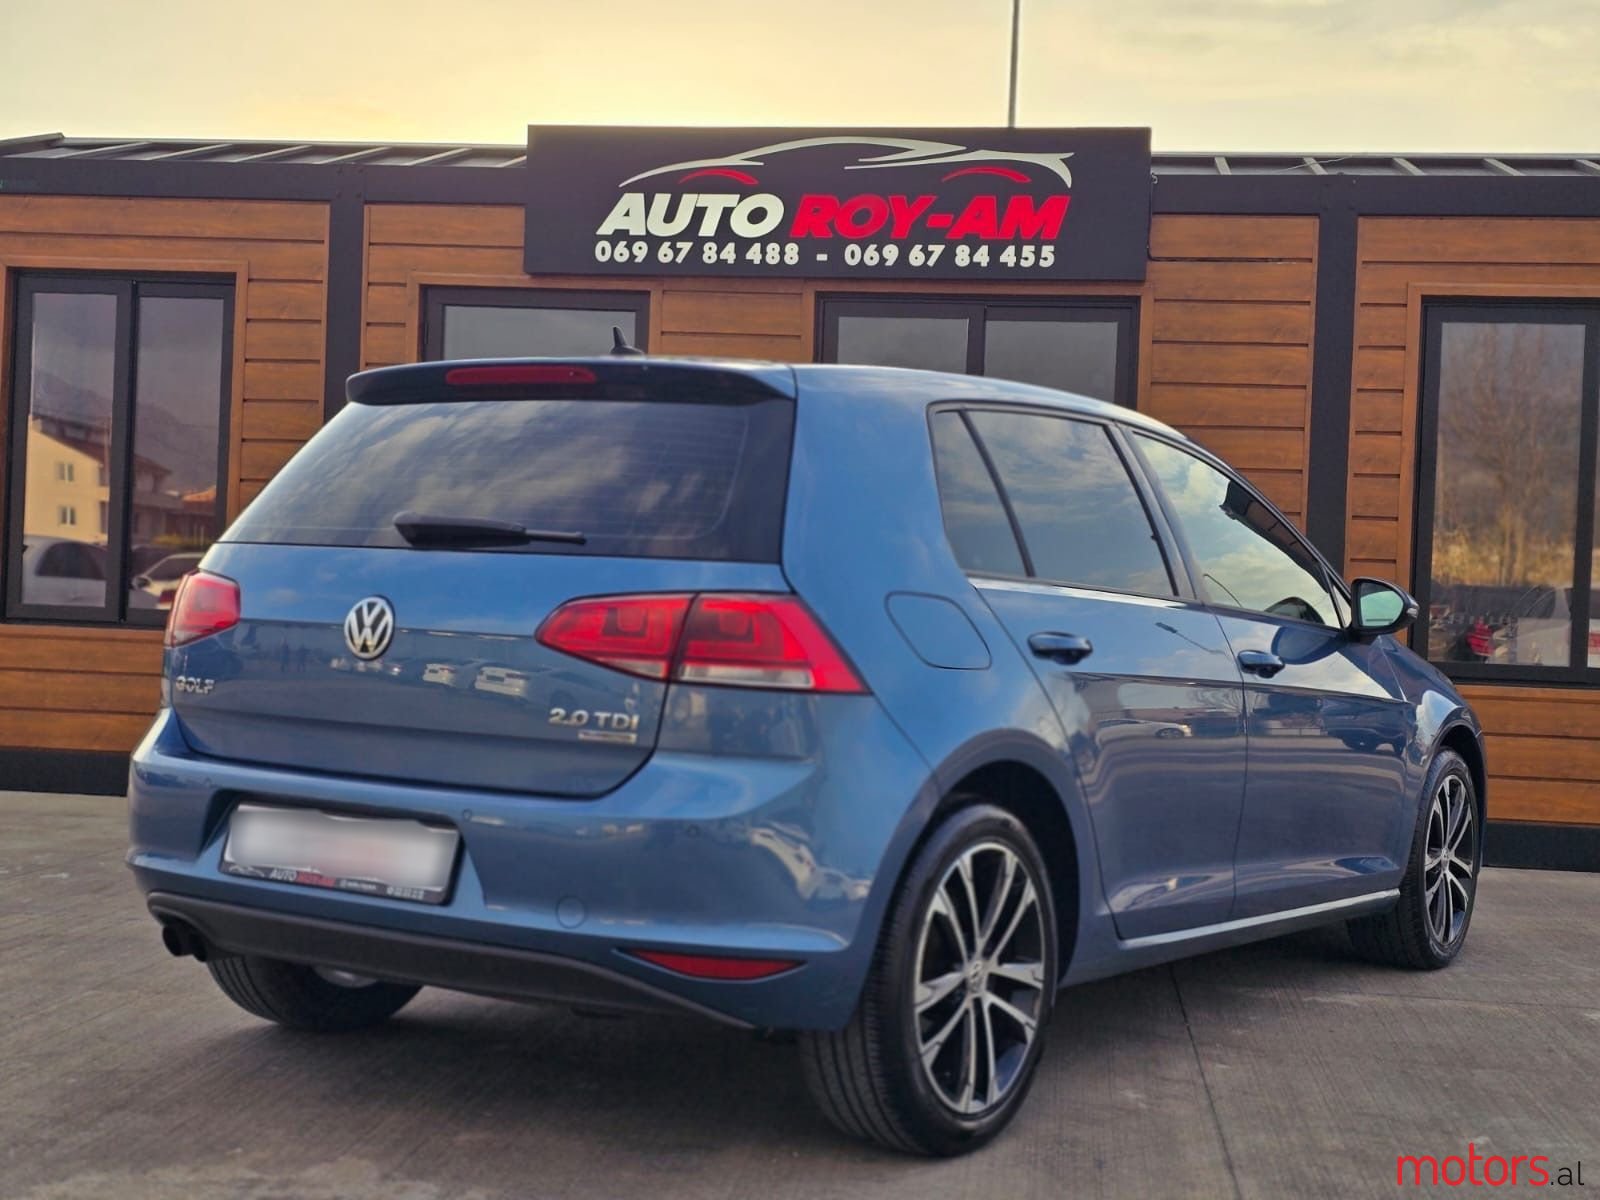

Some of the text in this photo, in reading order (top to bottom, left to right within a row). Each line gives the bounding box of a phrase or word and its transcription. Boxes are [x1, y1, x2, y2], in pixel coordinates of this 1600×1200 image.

[595, 192, 1071, 240] AUTO ROY-AM
[595, 240, 649, 263] 069
[657, 241, 694, 263] 67
[702, 241, 737, 264] 84
[745, 242, 799, 265] 488
[844, 243, 900, 266] 069
[908, 244, 946, 267] 67
[954, 244, 990, 267] 84
[999, 245, 1055, 268] 455
[344, 596, 394, 660] VW
[175, 675, 216, 695] GOLF
[549, 707, 640, 730] 2.0 TDI
[269, 868, 297, 882] AUTO
